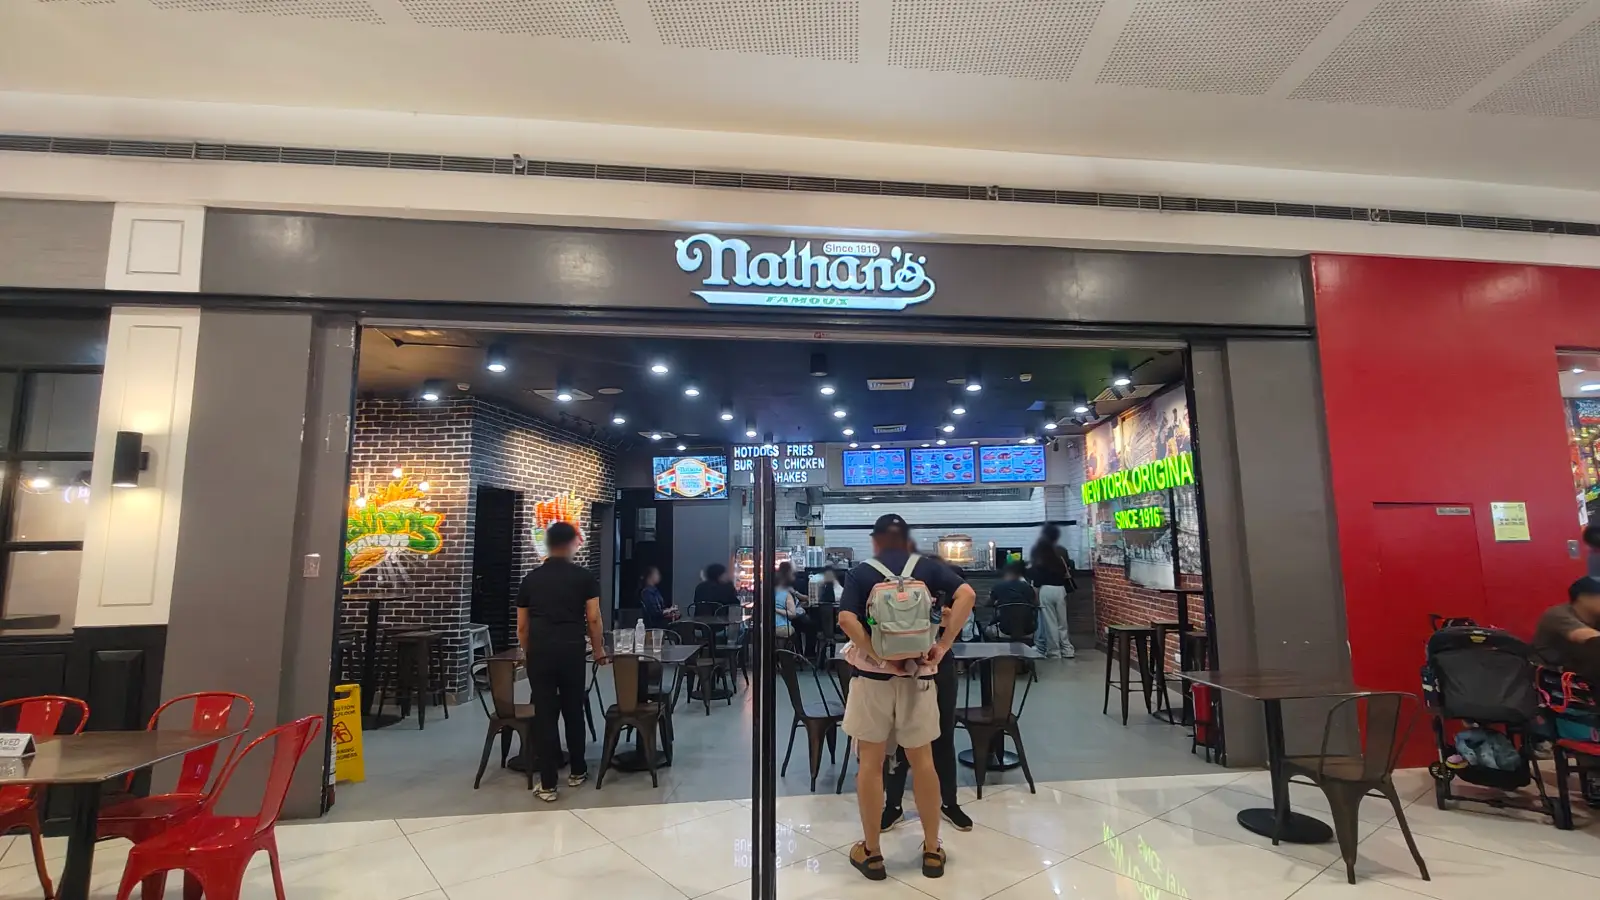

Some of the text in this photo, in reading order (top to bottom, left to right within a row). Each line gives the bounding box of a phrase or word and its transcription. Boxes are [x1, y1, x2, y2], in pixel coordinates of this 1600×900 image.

[824, 243, 878, 254] Since 1916
[733, 444, 814, 458] HOTDOGS FRIES
[733, 457, 825, 471] BURS CHICKEN
[749, 471, 808, 484] MHAKES
[1080, 451, 1195, 506] NEW YORK ORIGINA
[1114, 506, 1162, 530] SINCE 1916
